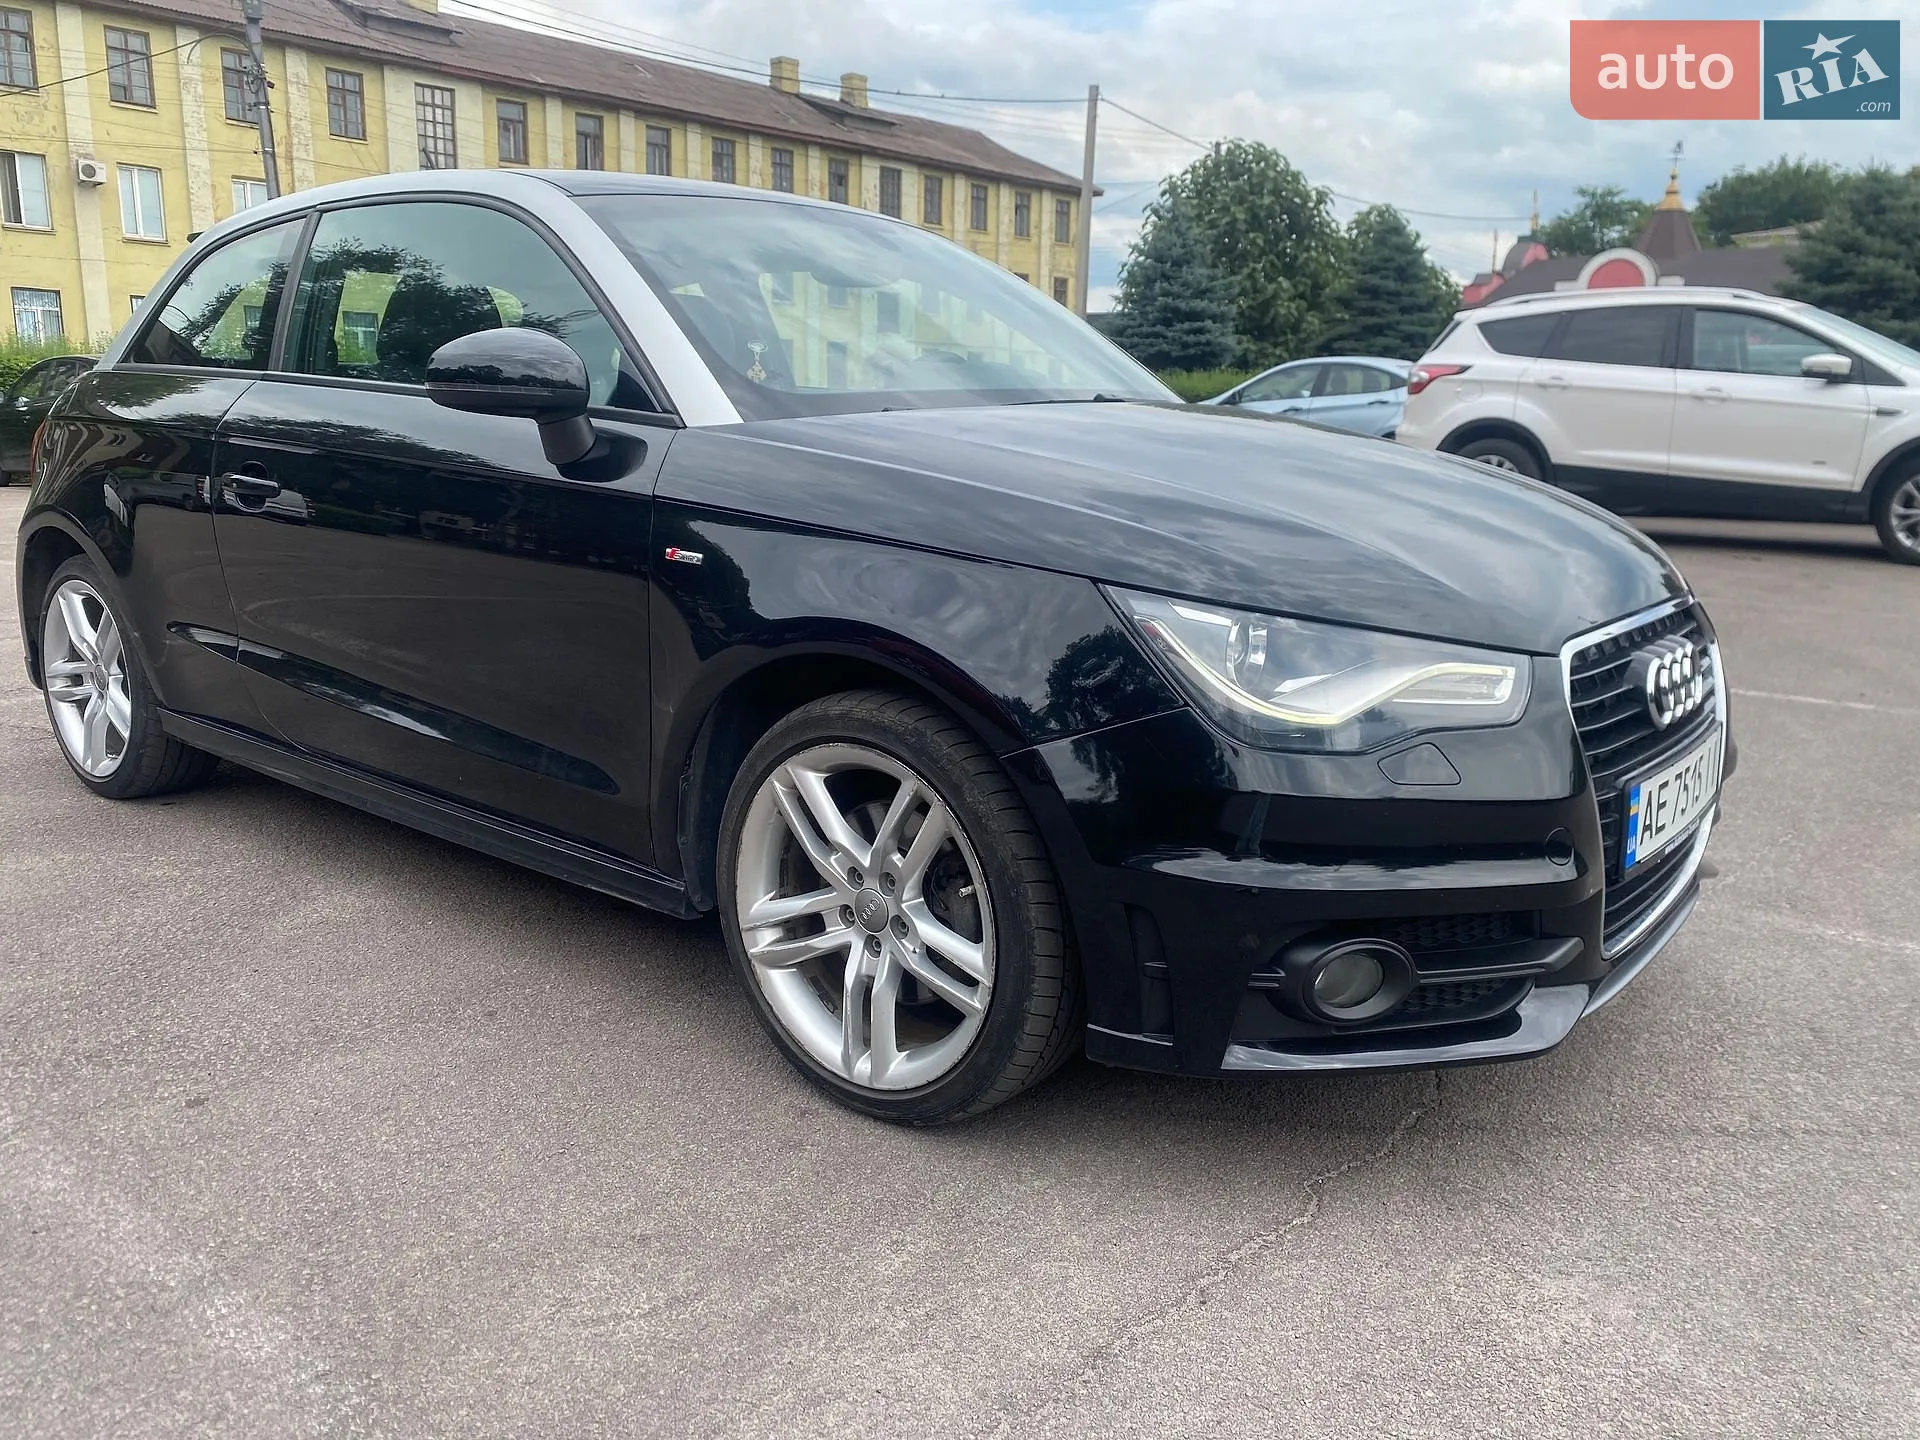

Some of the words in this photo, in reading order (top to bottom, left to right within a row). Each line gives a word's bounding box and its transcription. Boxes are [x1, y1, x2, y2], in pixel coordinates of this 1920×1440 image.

[1640, 780, 1669, 846] AE
[1671, 753, 1704, 825] 7515
[1626, 834, 1637, 855] UA
